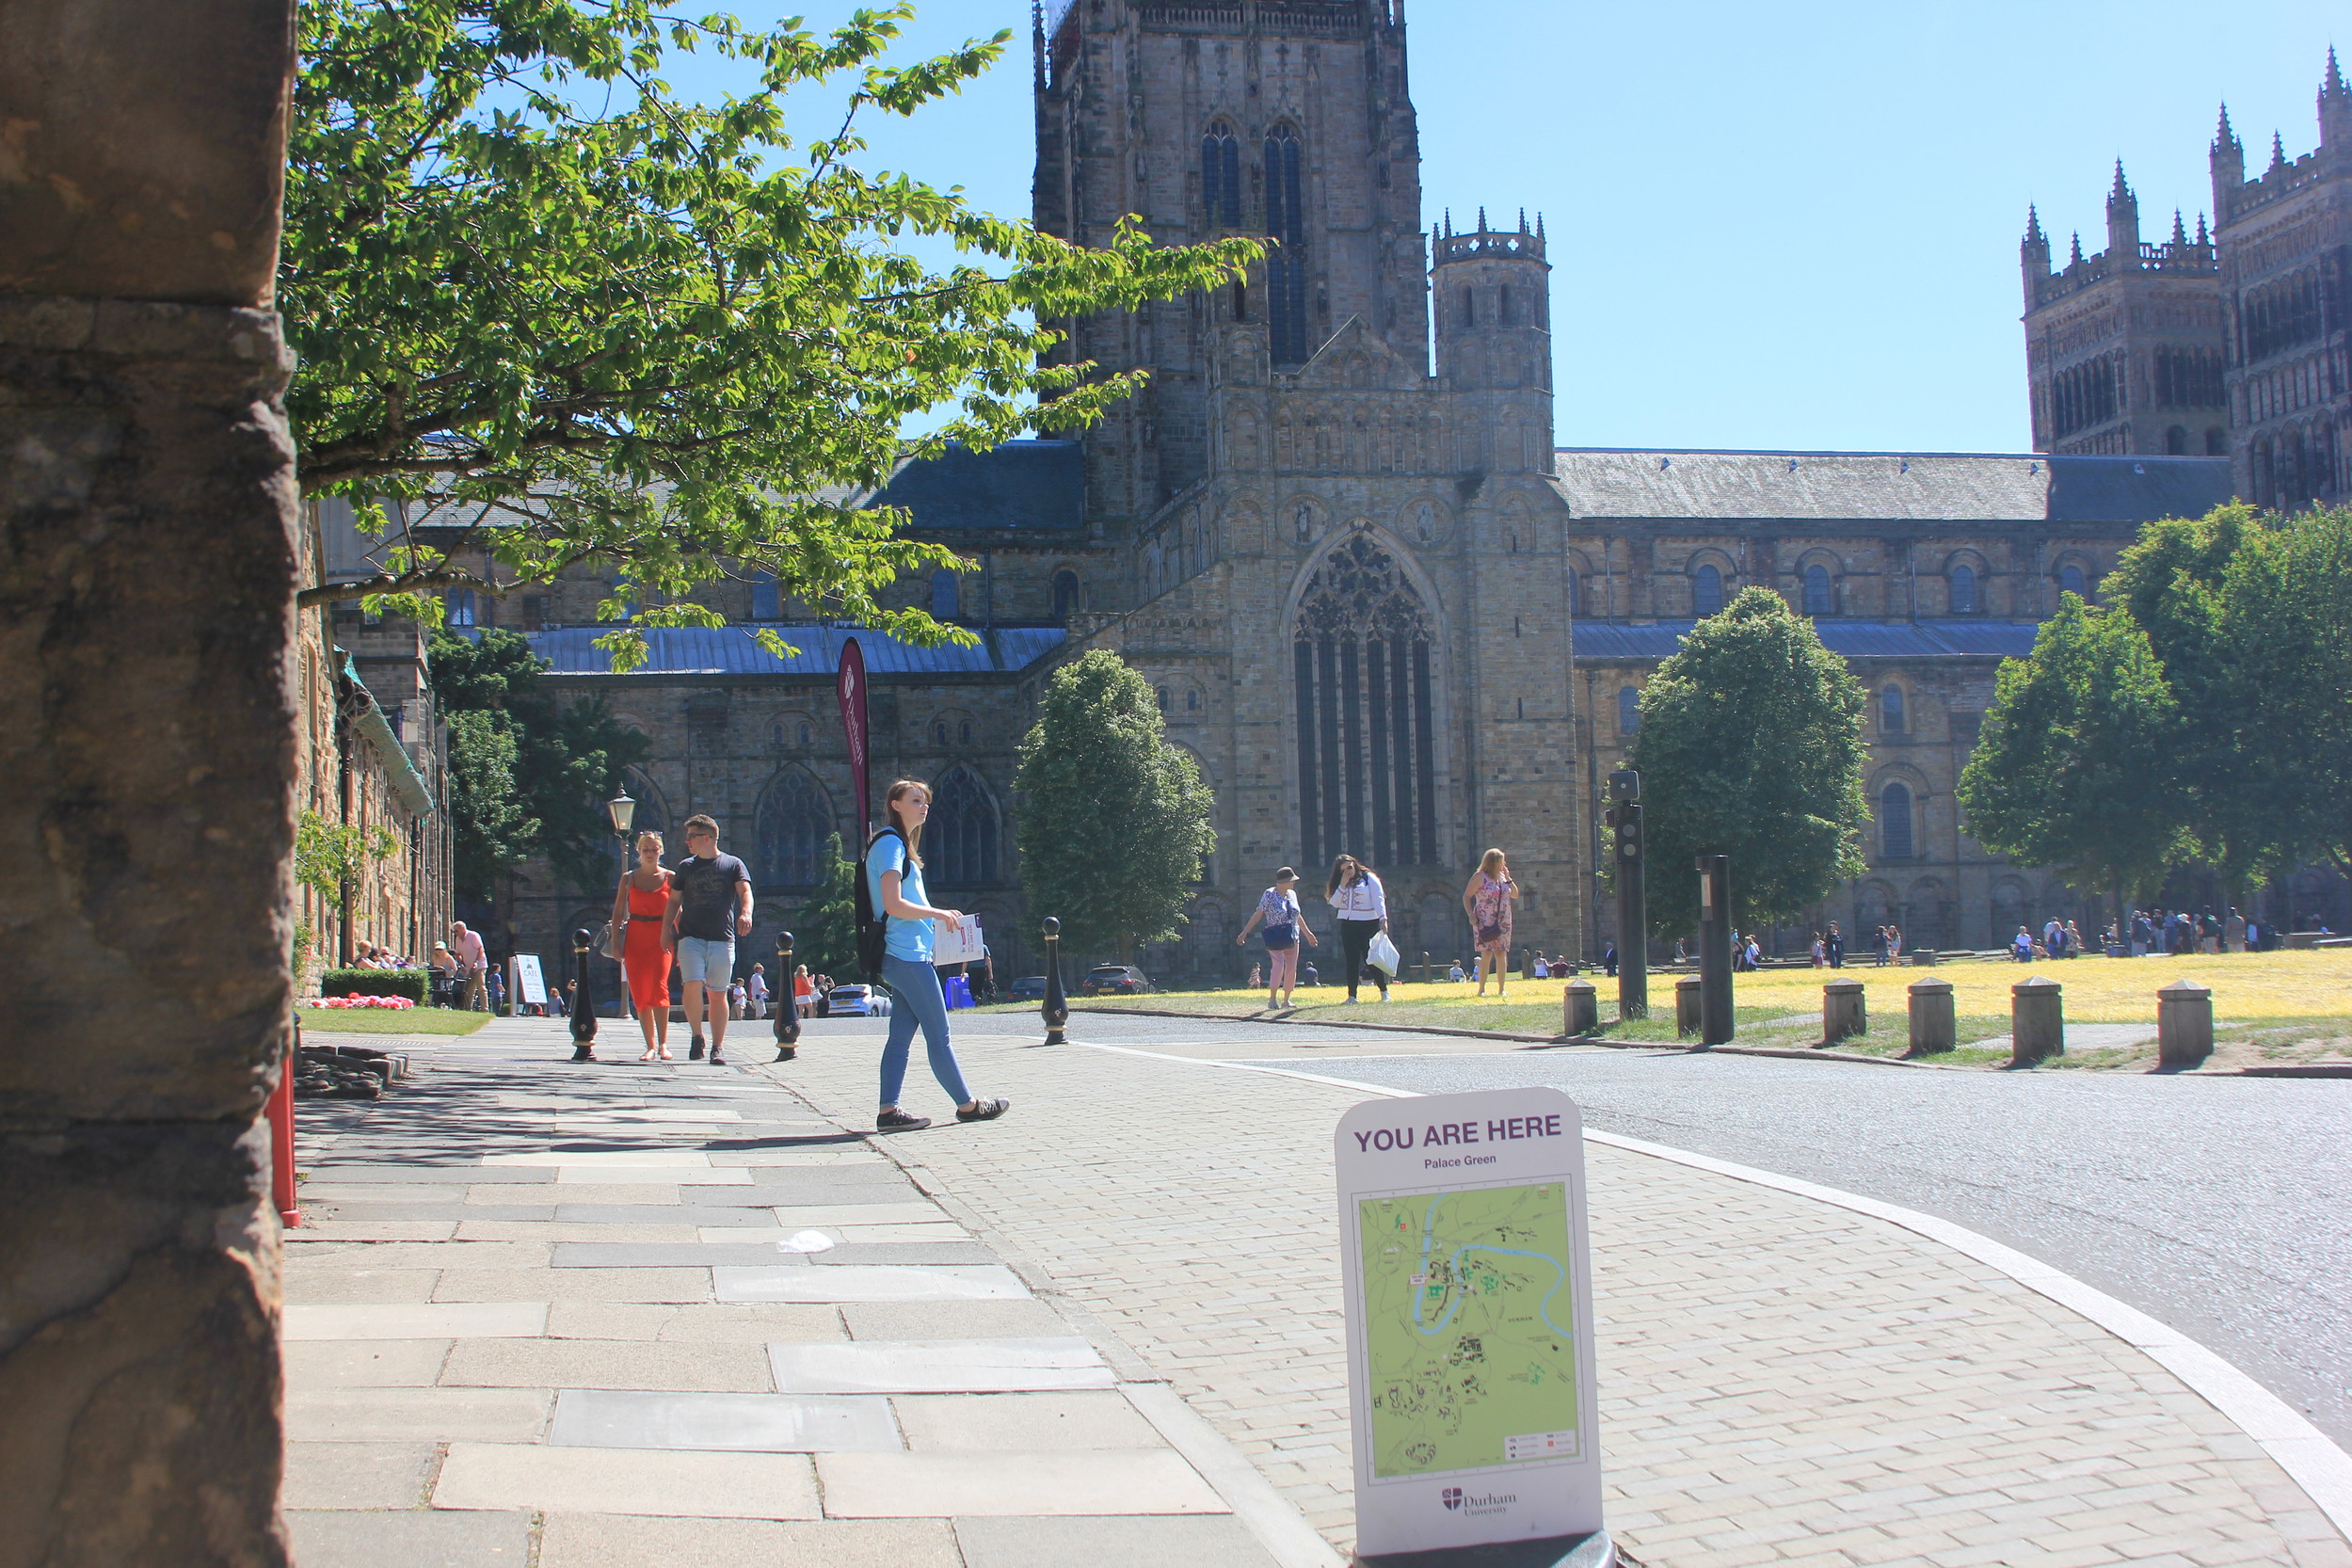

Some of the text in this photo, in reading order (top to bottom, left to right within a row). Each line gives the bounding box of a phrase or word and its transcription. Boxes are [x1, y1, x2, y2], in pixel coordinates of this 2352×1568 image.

[1353, 1114, 1561, 1152] YOU ARE HERE
[1424, 1155, 1496, 1169] Palace Green
[1464, 1493, 1516, 1507] Durham
[1464, 1507, 1507, 1516] University
